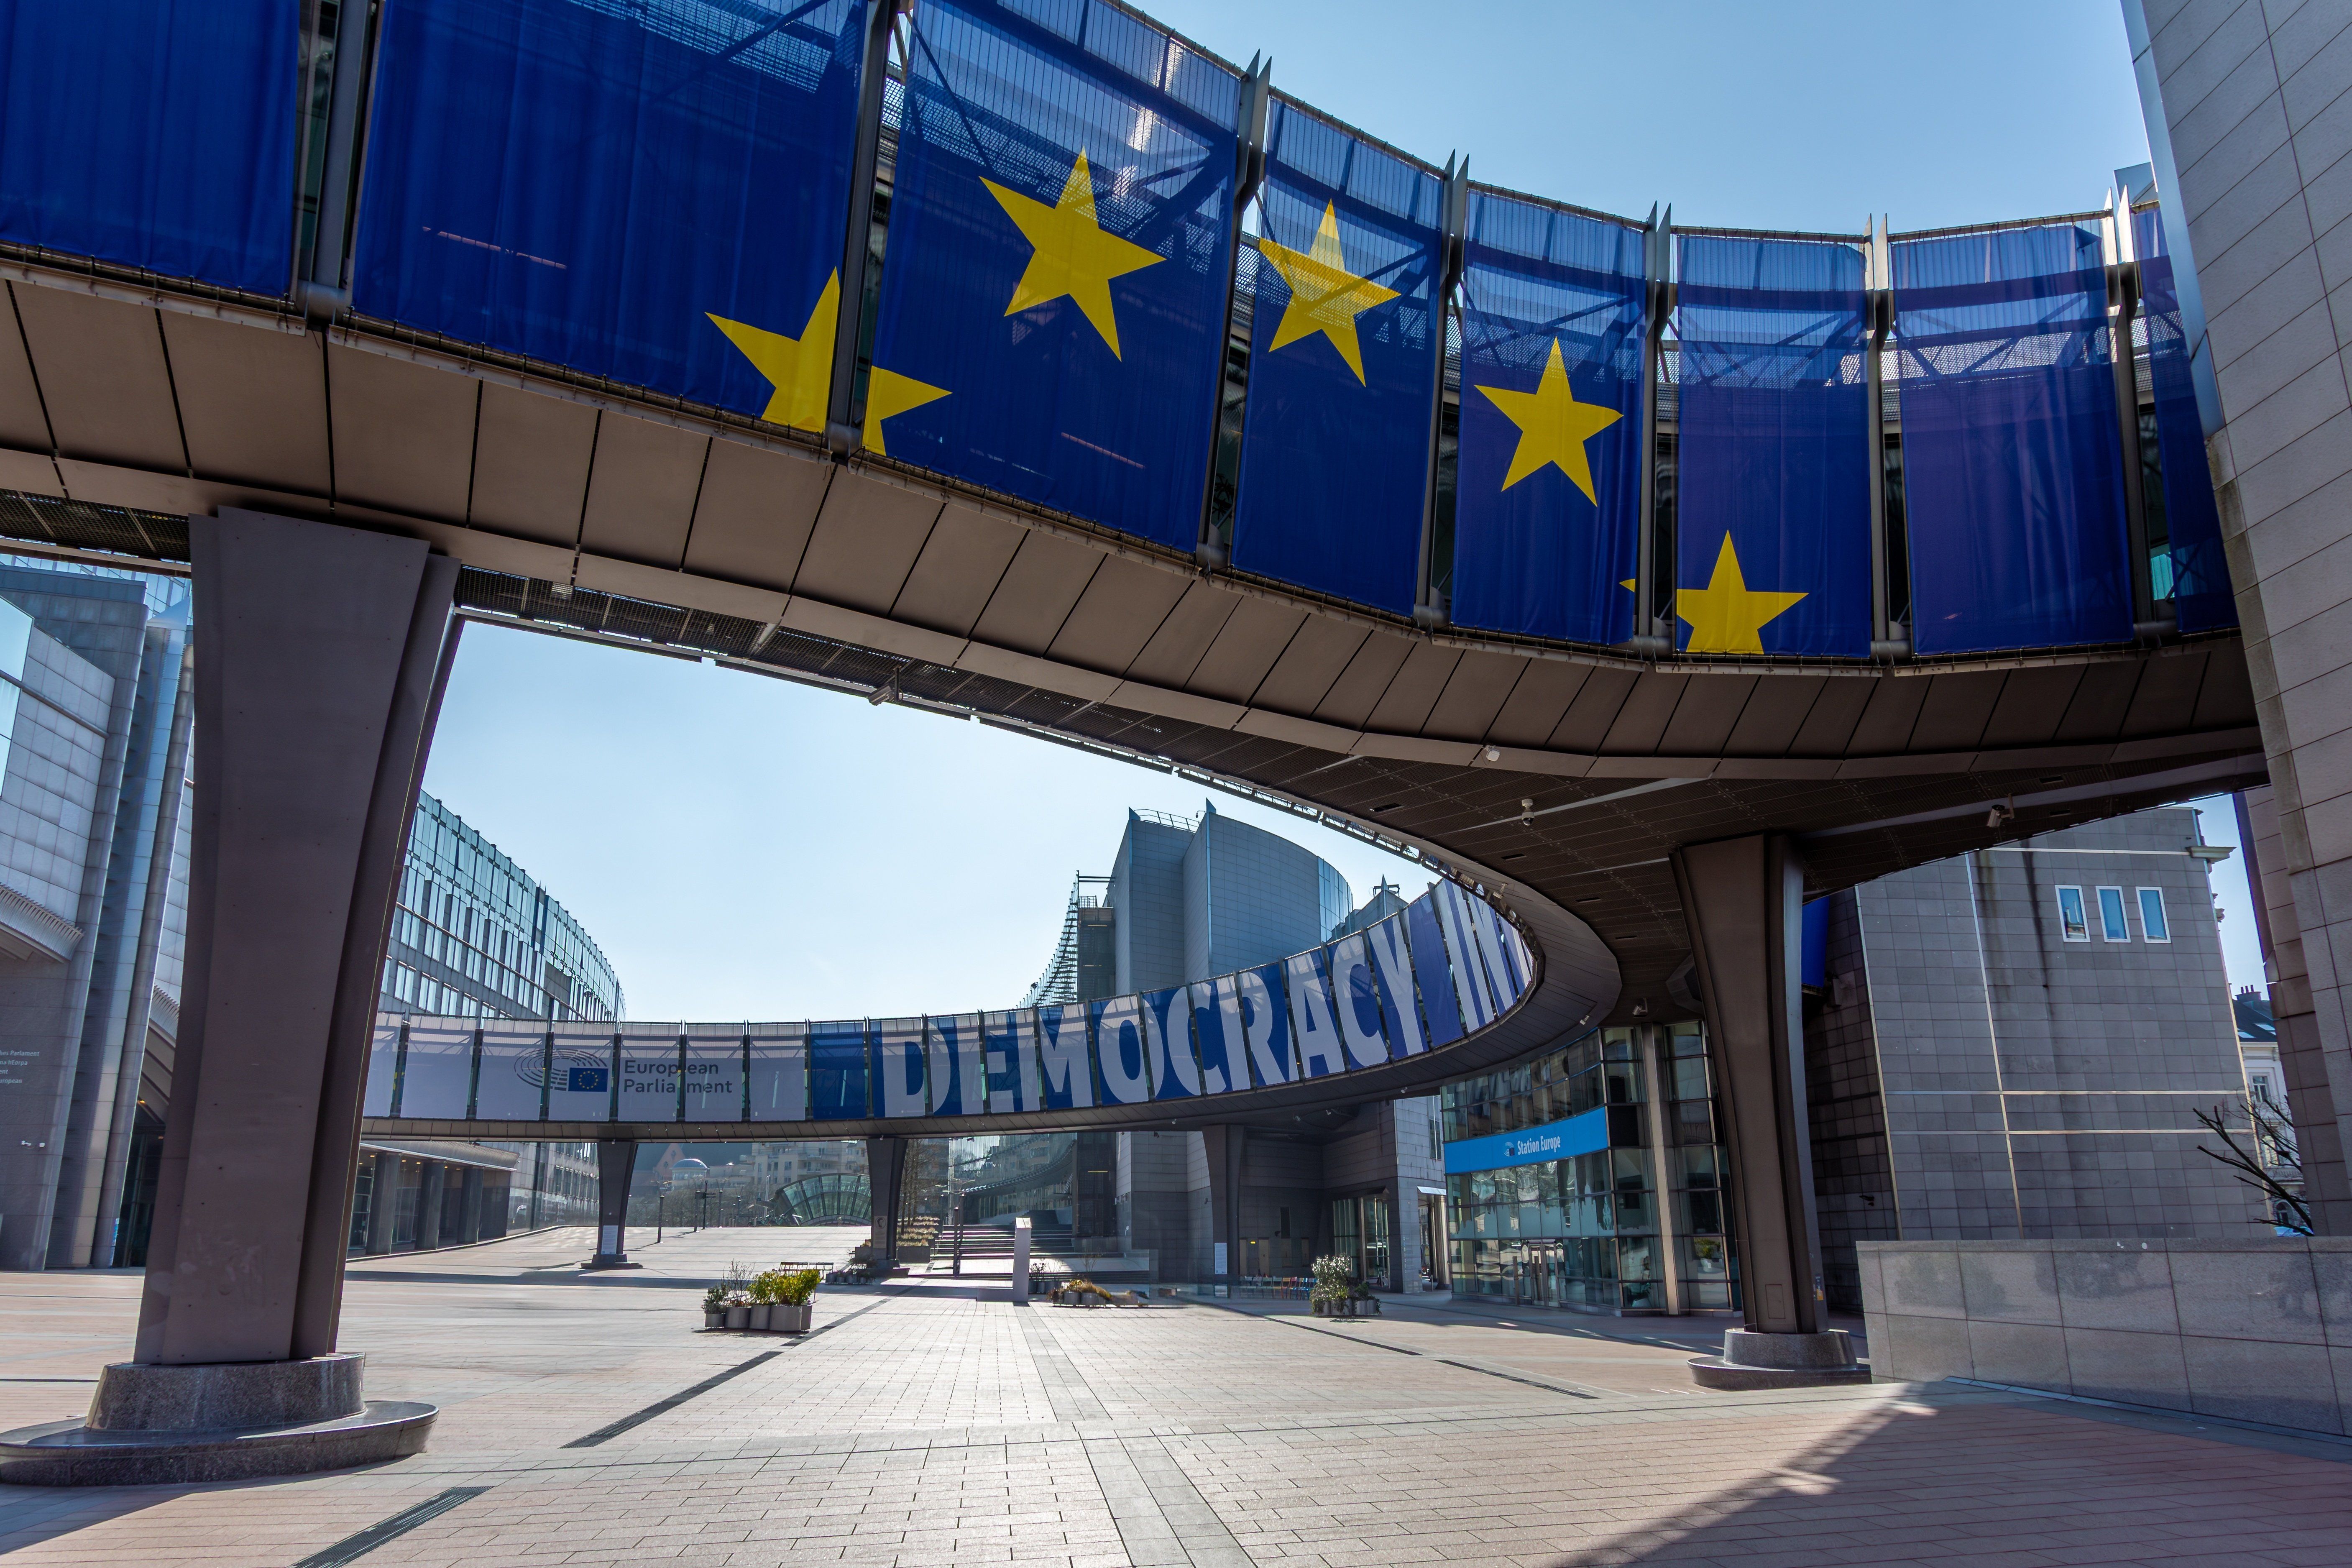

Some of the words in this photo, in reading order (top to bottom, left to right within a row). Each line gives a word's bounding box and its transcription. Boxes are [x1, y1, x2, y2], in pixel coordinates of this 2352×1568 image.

[880, 908, 1424, 1118] DEMOCRACY
[624, 1060, 718, 1077] European
[624, 1079, 732, 1093] Parliament
[1517, 1138, 1540, 1155] Station
[1540, 1136, 1561, 1153] Europe
